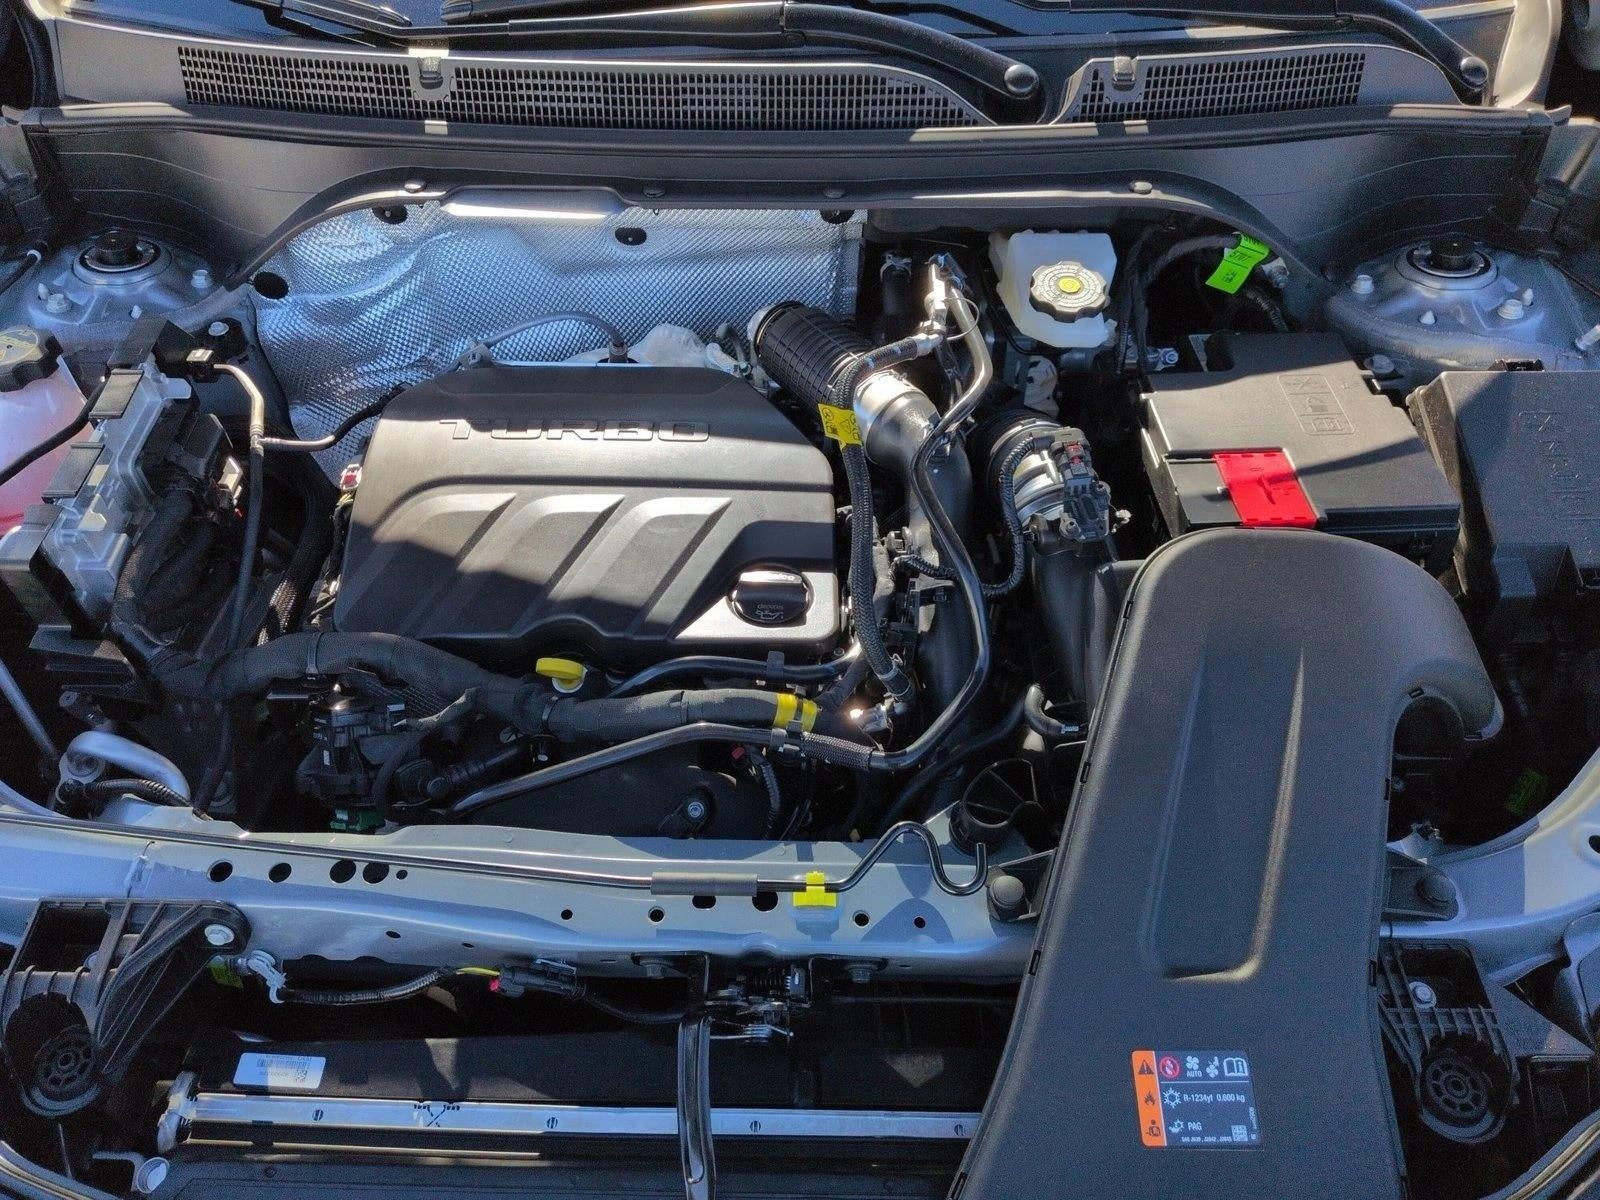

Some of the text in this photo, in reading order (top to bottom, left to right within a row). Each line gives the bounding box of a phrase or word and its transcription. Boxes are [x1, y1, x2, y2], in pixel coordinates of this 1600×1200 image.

[439, 418, 710, 442] TURBO
[1183, 1094, 1213, 1103] R-1234yf
[1236, 1094, 1246, 1103] kg
[1188, 1122, 1202, 1130] PAG
